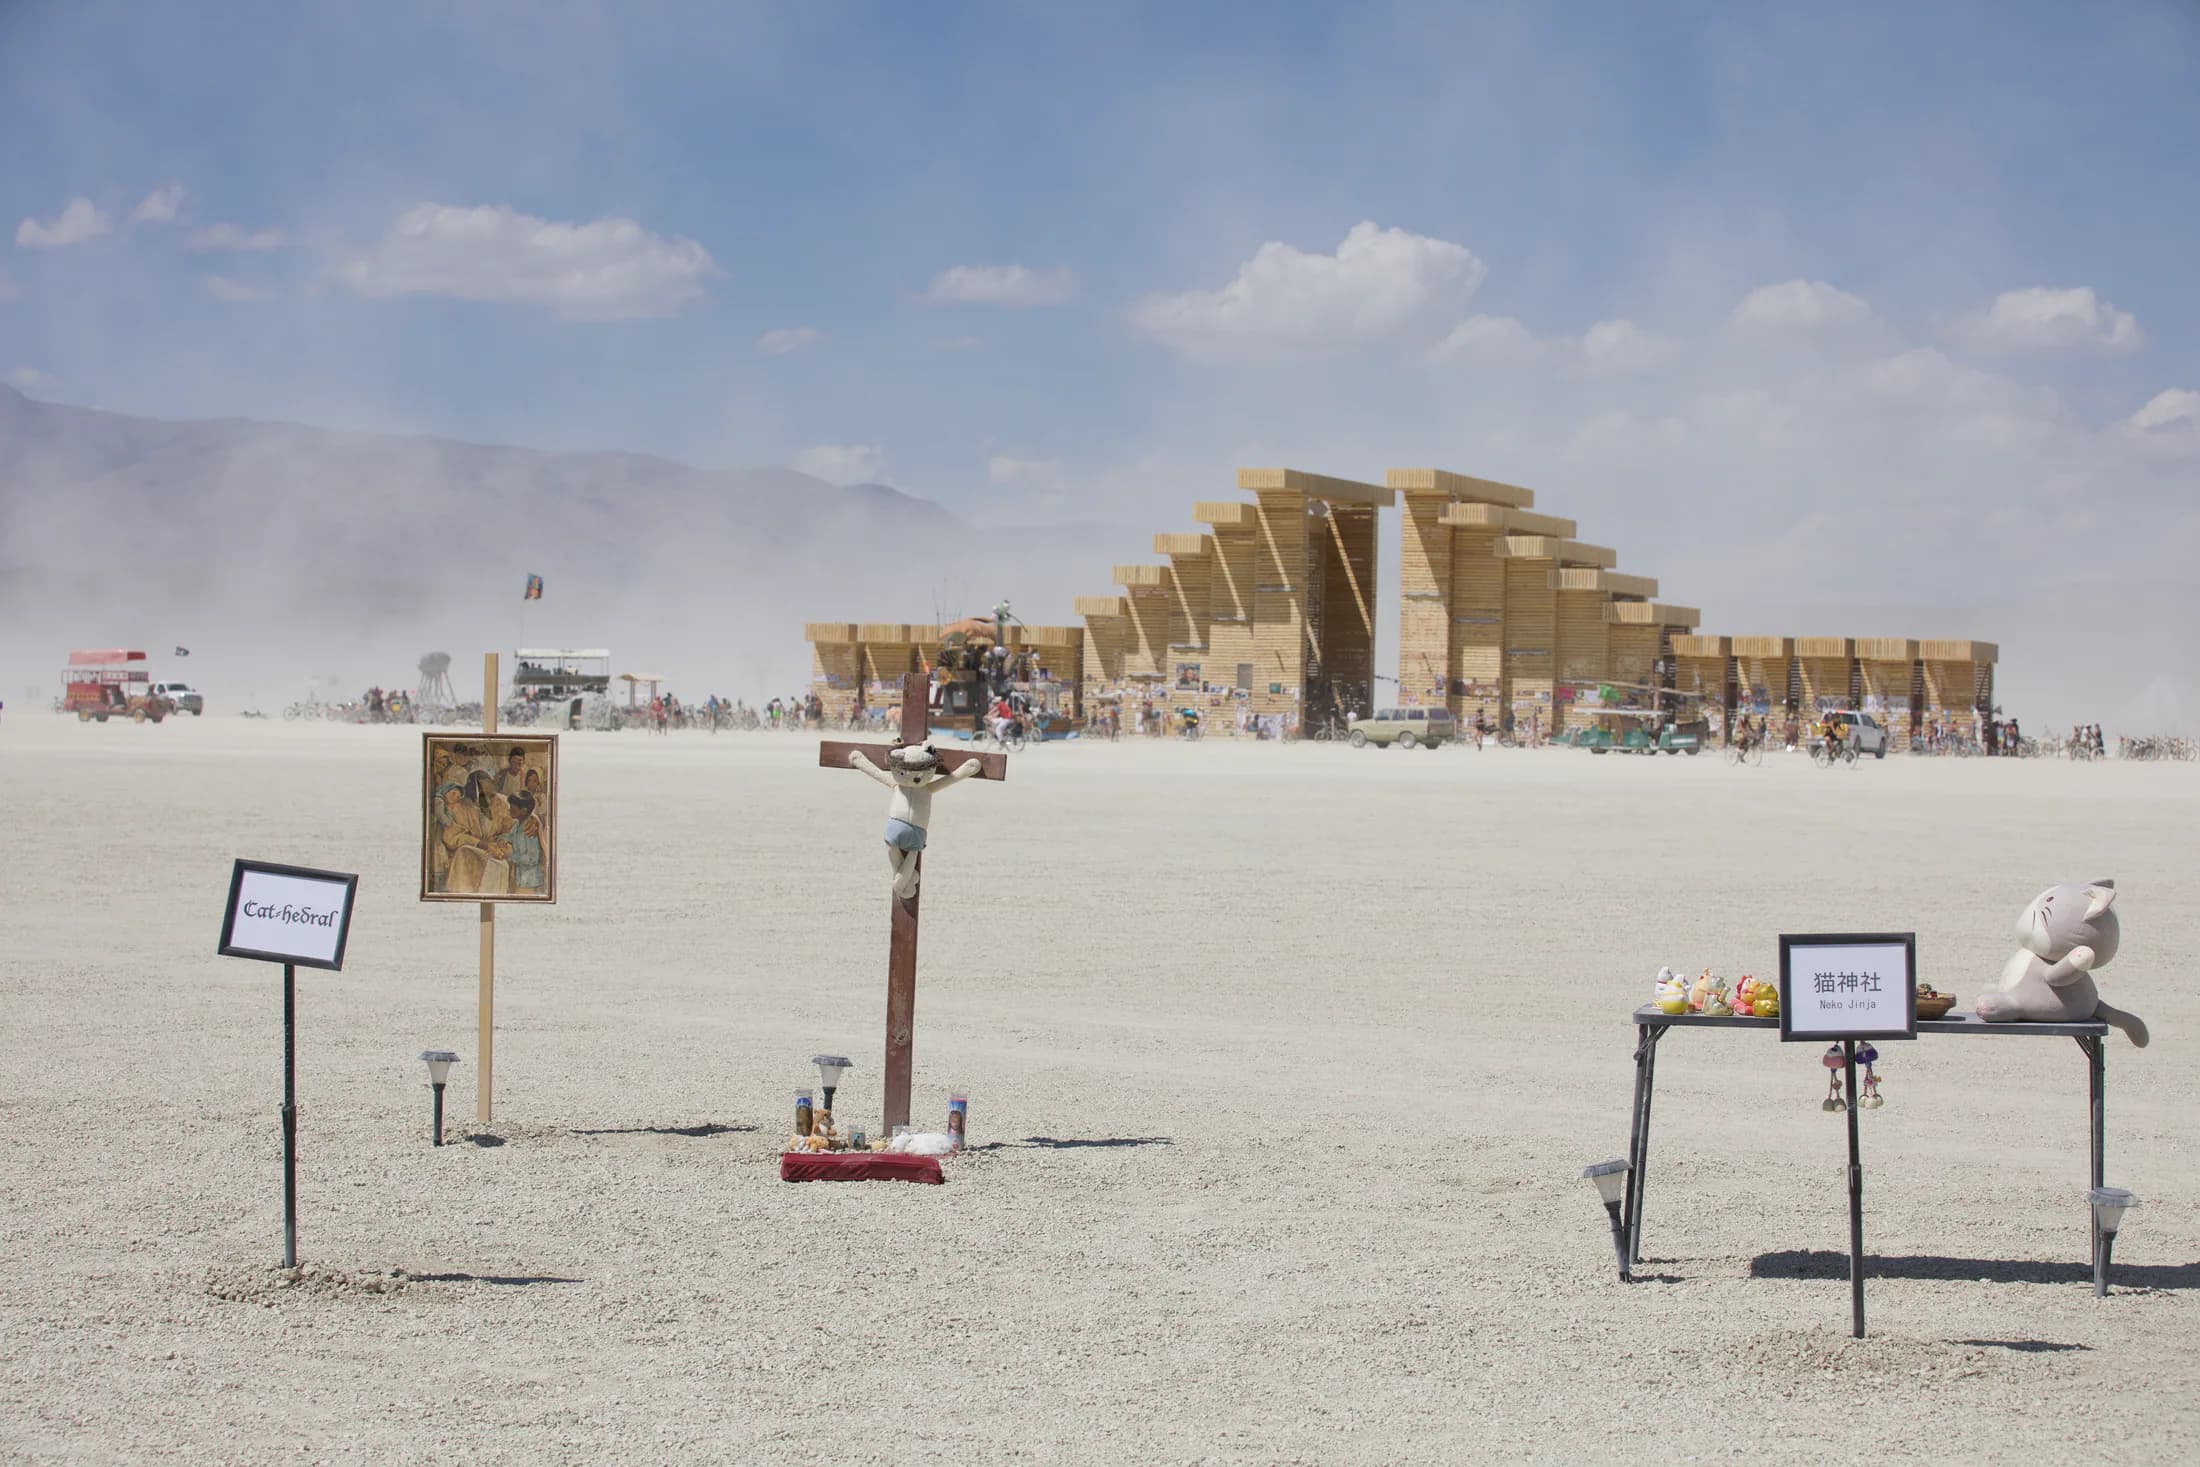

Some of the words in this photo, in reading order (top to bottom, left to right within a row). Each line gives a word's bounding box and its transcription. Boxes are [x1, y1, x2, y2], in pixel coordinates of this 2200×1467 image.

[1813, 971, 1882, 994] 猫神社
[1819, 999, 1843, 1010] Neko
[1848, 999, 1876, 1011] Jinja
